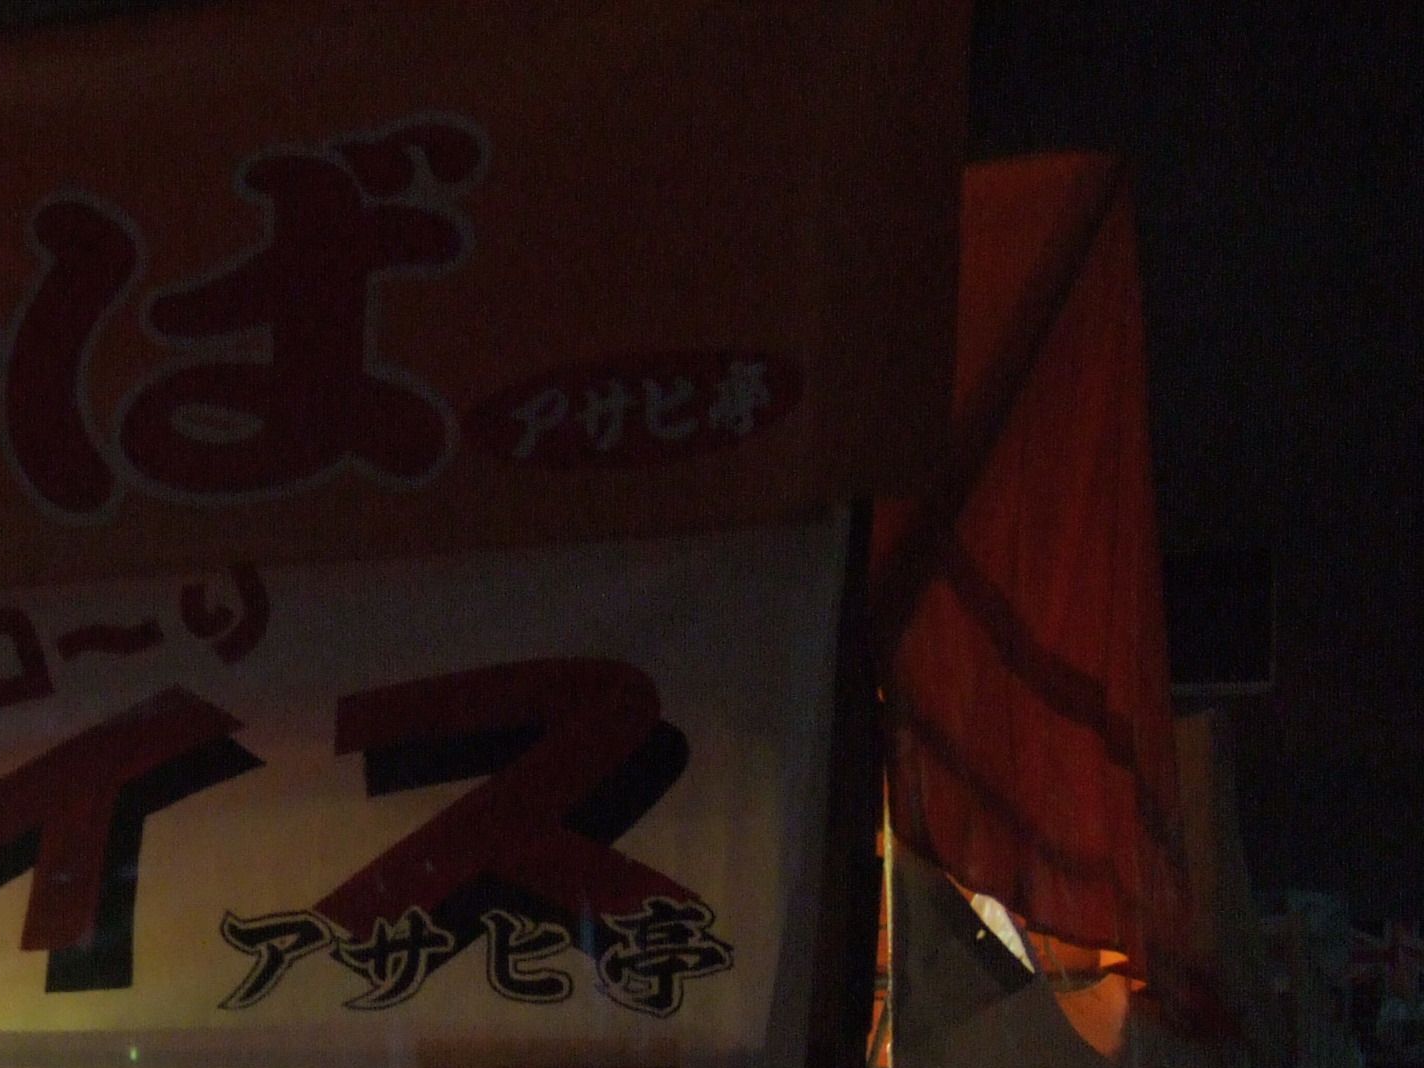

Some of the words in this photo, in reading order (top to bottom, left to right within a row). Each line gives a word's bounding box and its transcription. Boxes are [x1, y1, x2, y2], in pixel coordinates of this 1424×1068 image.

[512, 361, 773, 458] アサヒ亭
[218, 898, 732, 1017] アサヒ亭
